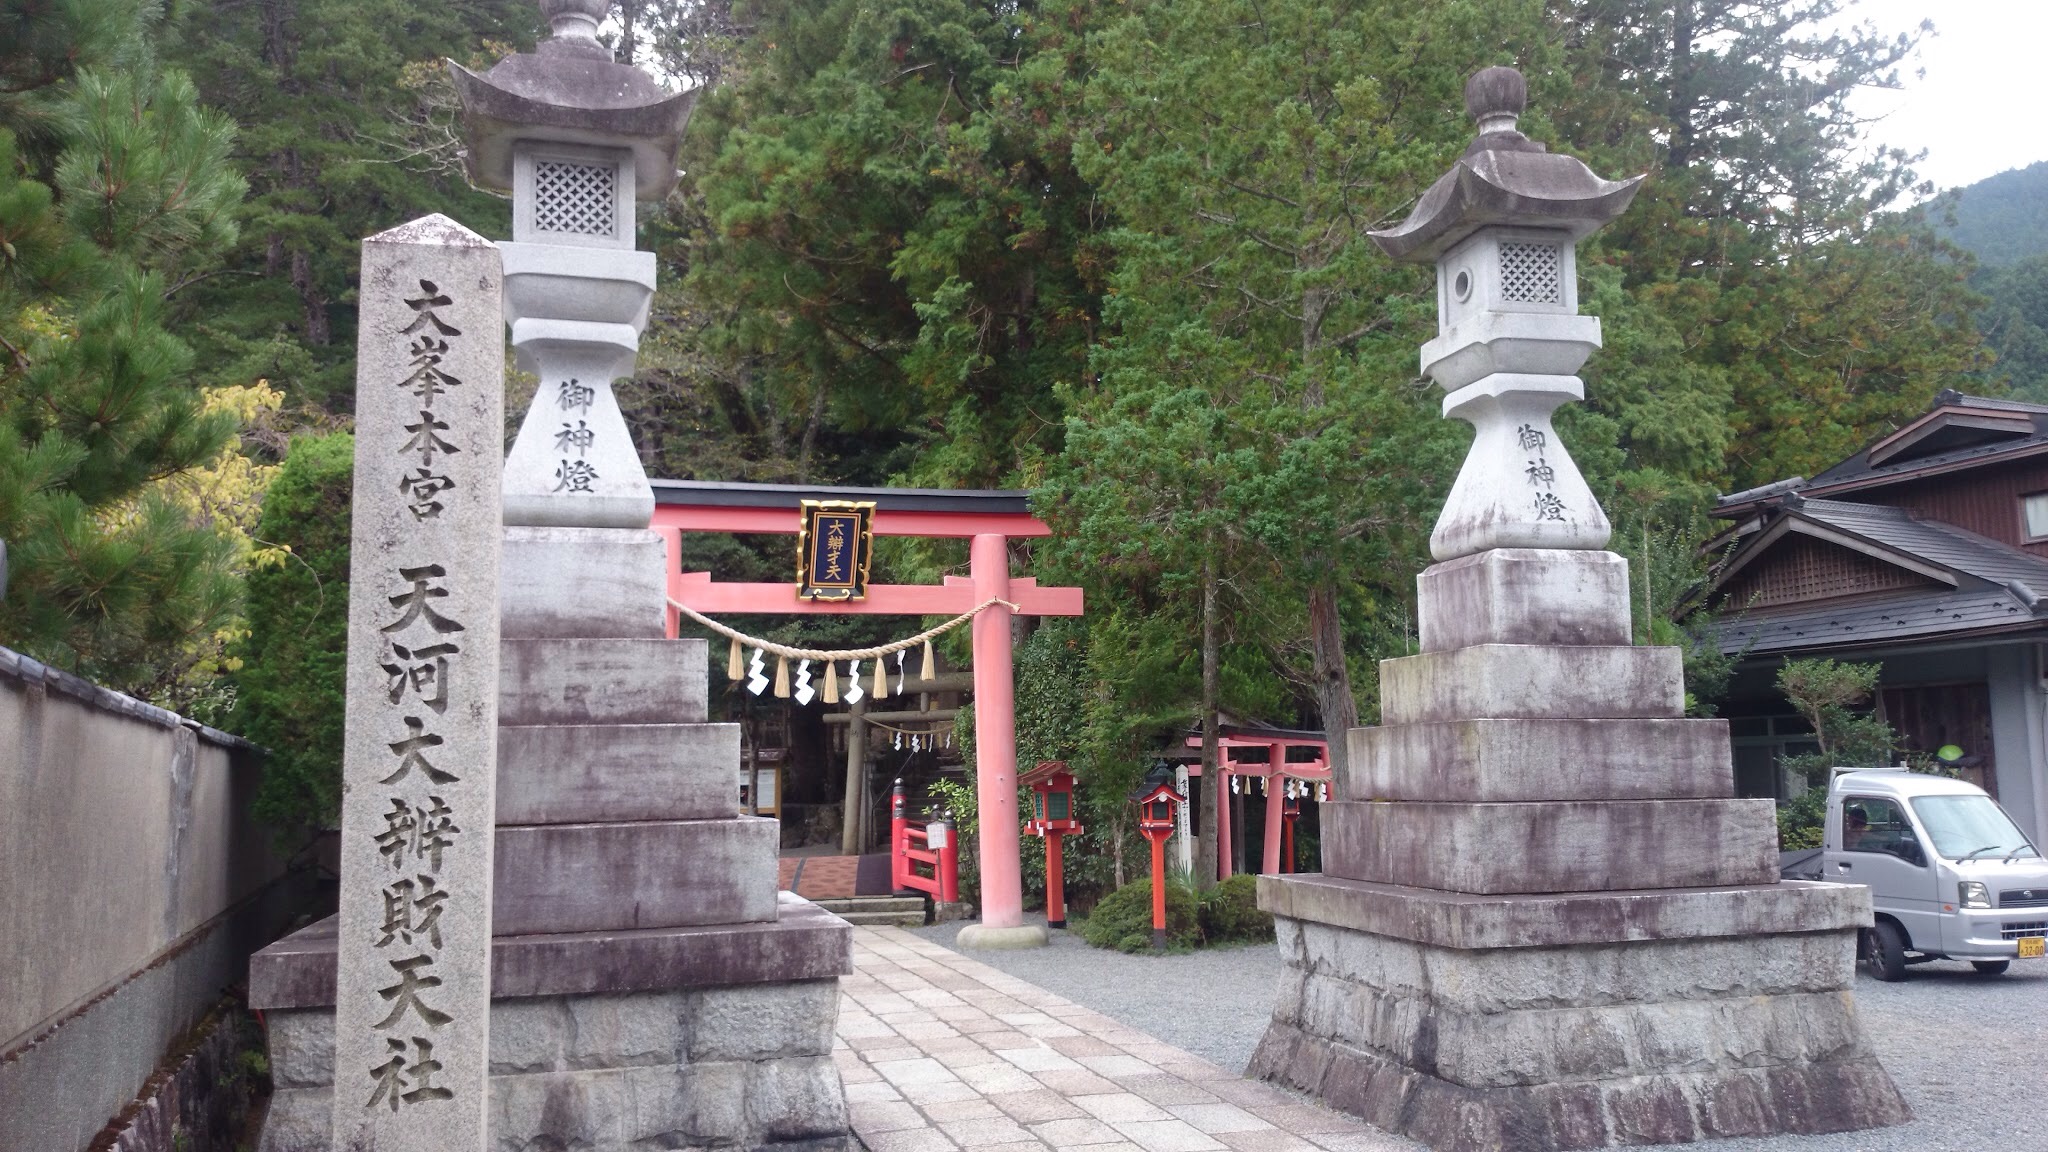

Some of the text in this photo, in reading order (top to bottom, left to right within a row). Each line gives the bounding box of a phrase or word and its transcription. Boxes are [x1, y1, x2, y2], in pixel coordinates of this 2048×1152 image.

[552, 378, 600, 494] 御神燈
[1517, 423, 1567, 522] 御神燈
